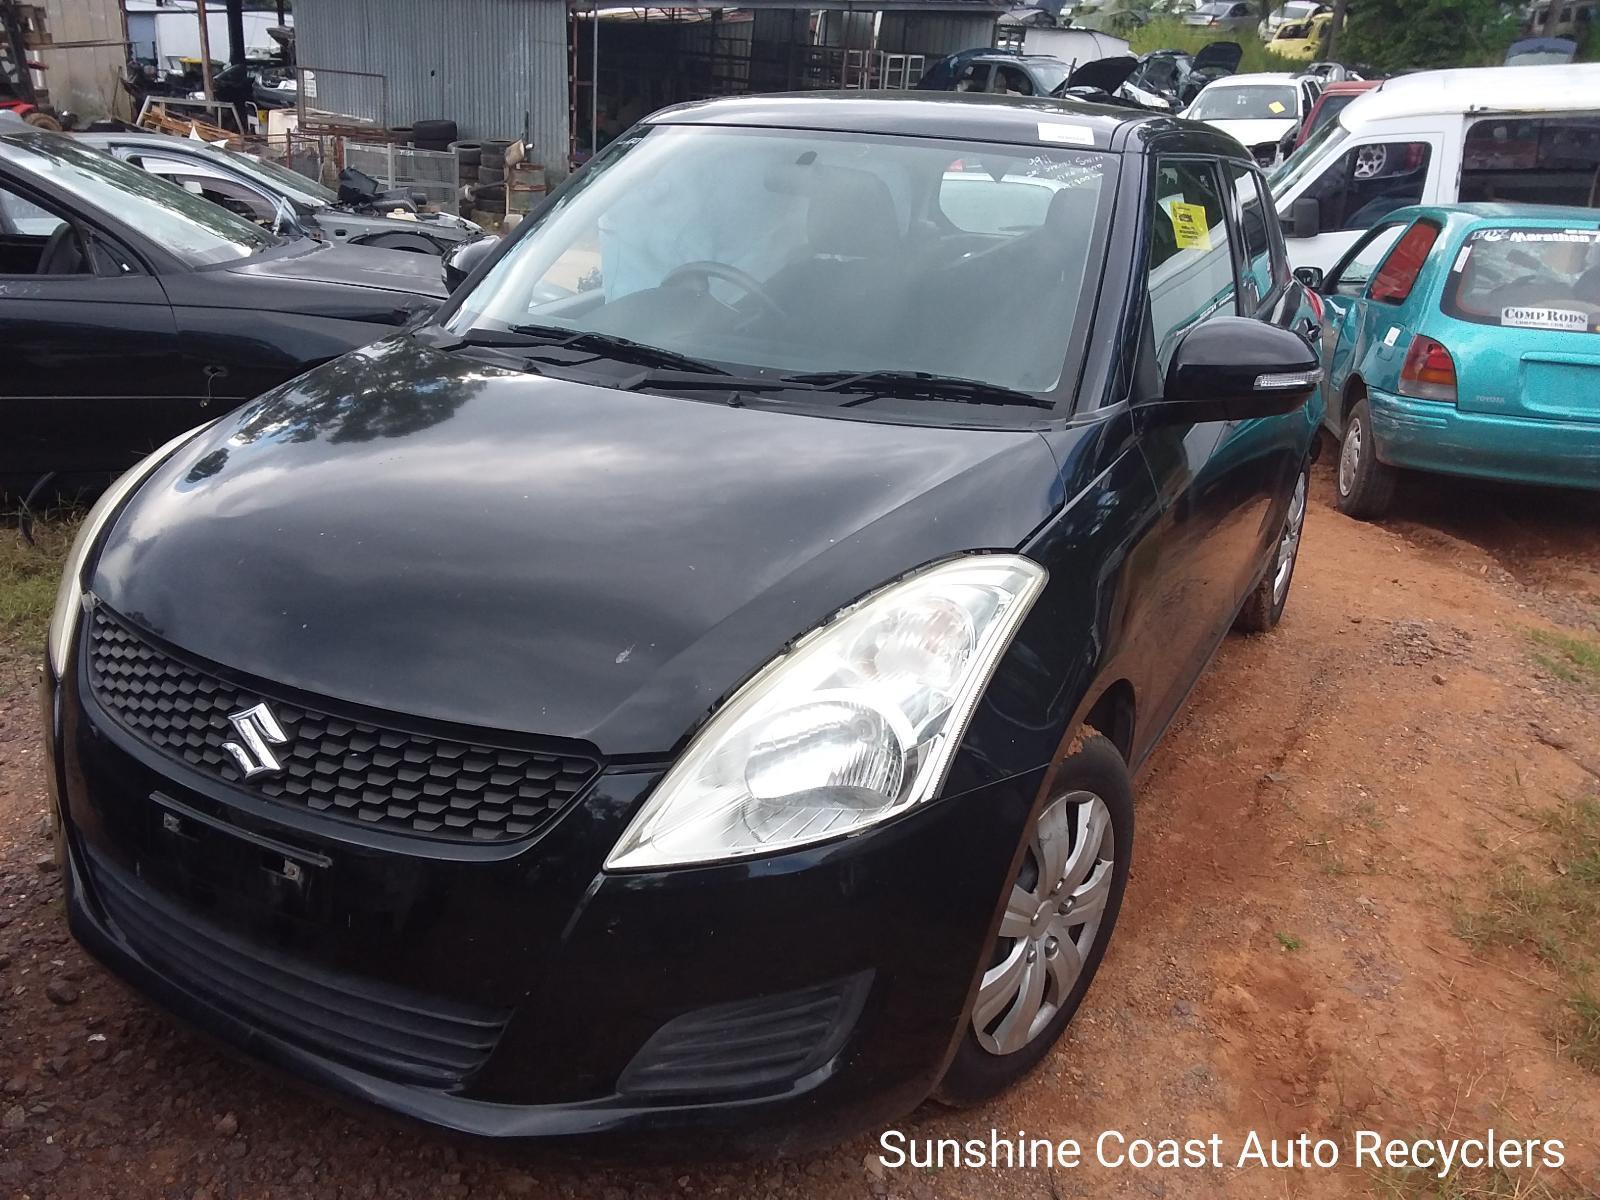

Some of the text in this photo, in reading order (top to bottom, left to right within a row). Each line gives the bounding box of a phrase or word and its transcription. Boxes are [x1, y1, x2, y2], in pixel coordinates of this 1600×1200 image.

[1509, 231, 1590, 243] Marathon
[1504, 307, 1586, 324] COMP RODS
